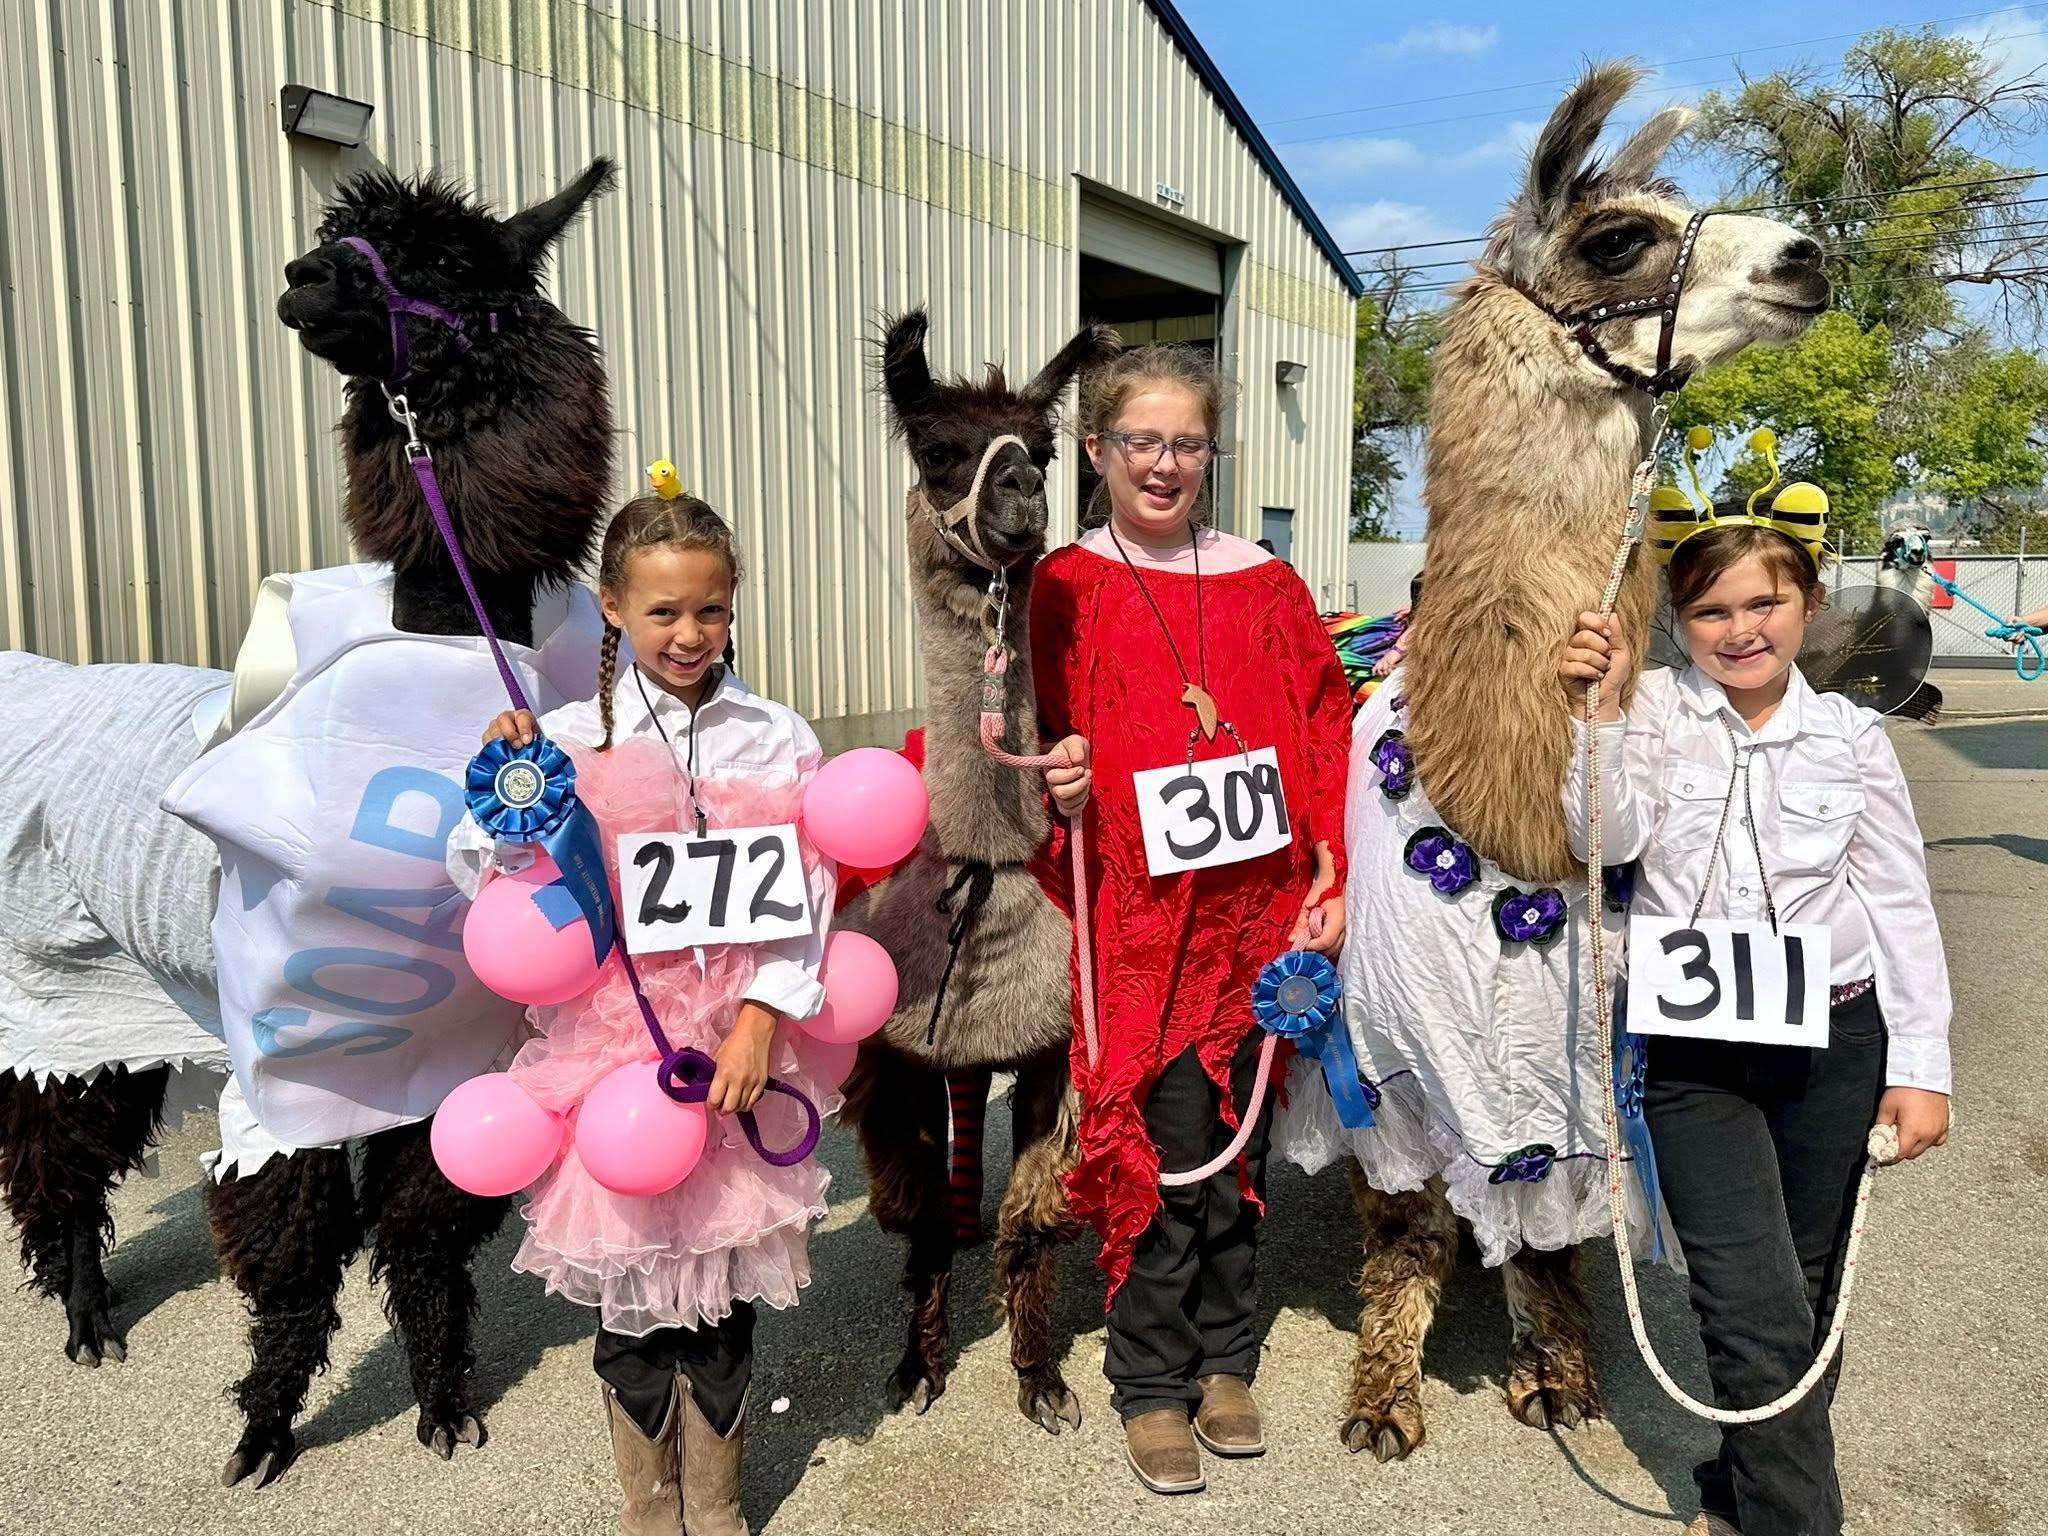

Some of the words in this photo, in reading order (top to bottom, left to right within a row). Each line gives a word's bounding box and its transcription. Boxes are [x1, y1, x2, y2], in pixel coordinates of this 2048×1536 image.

[1159, 763, 1289, 860] 309
[633, 835, 803, 927] 272
[1657, 928, 1805, 1025] 311
